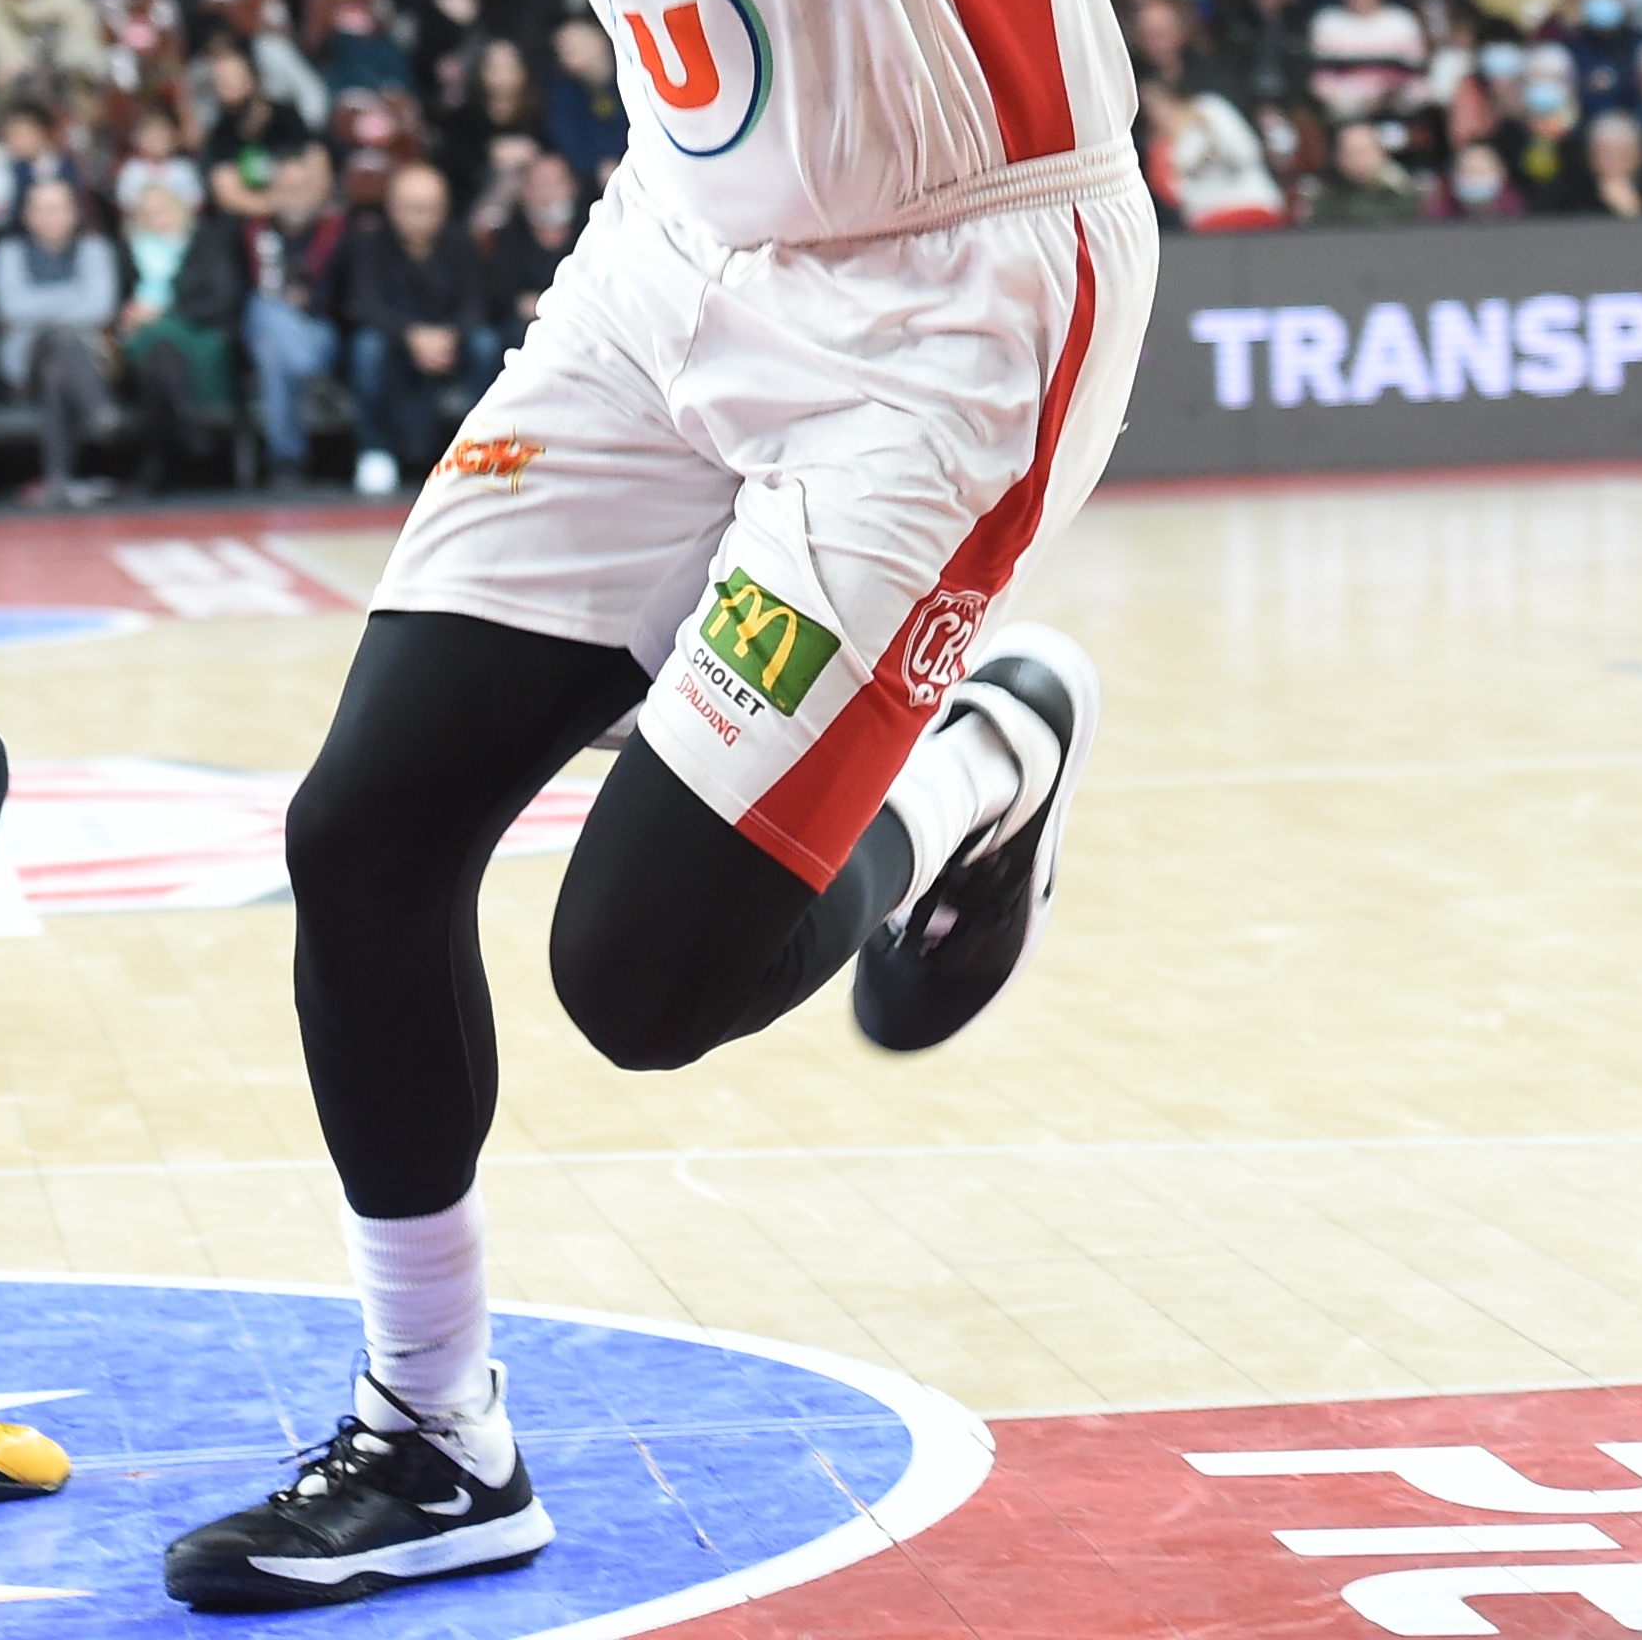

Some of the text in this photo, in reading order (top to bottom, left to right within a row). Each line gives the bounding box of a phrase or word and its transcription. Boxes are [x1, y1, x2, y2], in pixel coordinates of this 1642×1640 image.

[624, 0, 721, 111] U
[675, 672, 741, 748] SPALDING
[691, 648, 766, 718] CHOLET
